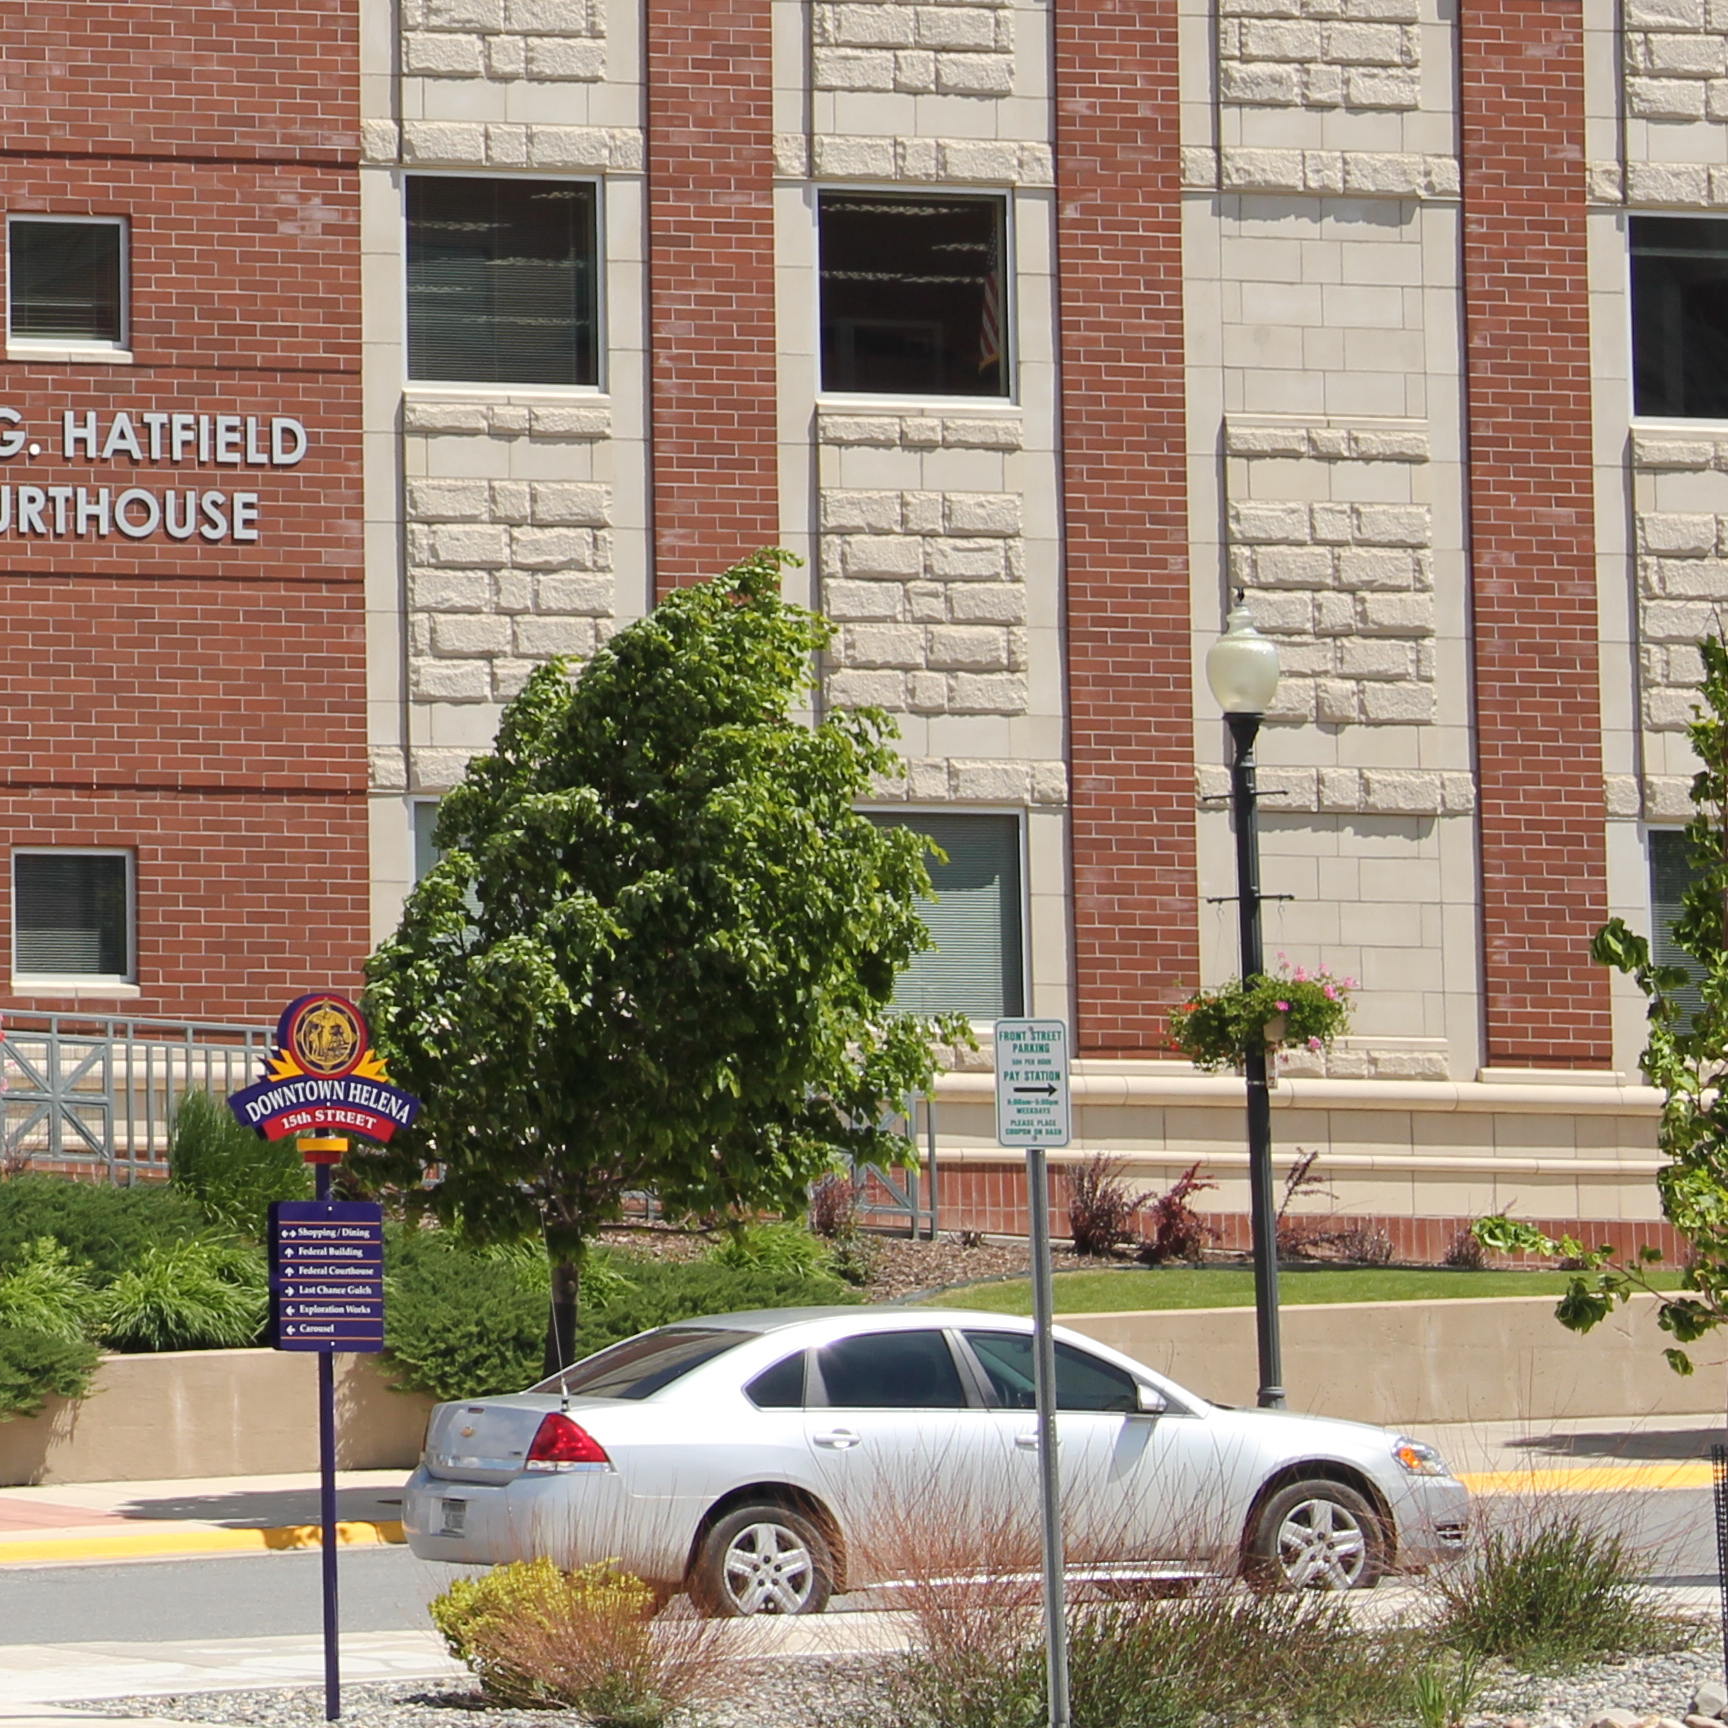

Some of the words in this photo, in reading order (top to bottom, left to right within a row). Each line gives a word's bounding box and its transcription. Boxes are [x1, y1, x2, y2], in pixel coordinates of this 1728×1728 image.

[64, 410, 308, 466] HATFIELD
[999, 1031, 1026, 1041] FRONT
[1030, 1031, 1062, 1041] STREET
[1012, 1043, 1050, 1053] PARKING
[1003, 1071, 1020, 1081] PAY
[1024, 1071, 1061, 1081] STATION
[245, 1080, 346, 1122] DOWNTOWN
[348, 1082, 411, 1124] HELENA
[281, 1113, 312, 1129] 15th
[315, 1109, 377, 1129] STREET
[1010, 1119, 1034, 1127] PLEASE
[1037, 1119, 1056, 1127] PLACE
[297, 1227, 336, 1239] Shopping
[342, 1227, 370, 1239] Dining
[298, 1246, 327, 1256] Federal
[328, 1247, 363, 1258] Building
[298, 1266, 327, 1275] Federal
[328, 1266, 374, 1275] Courthouse
[299, 1285, 316, 1294] Last
[317, 1285, 346, 1295] Chance
[347, 1285, 372, 1295] Gulch
[299, 1304, 345, 1316] Exploration
[345, 1305, 371, 1314] Works
[299, 1324, 335, 1333] Carousel
